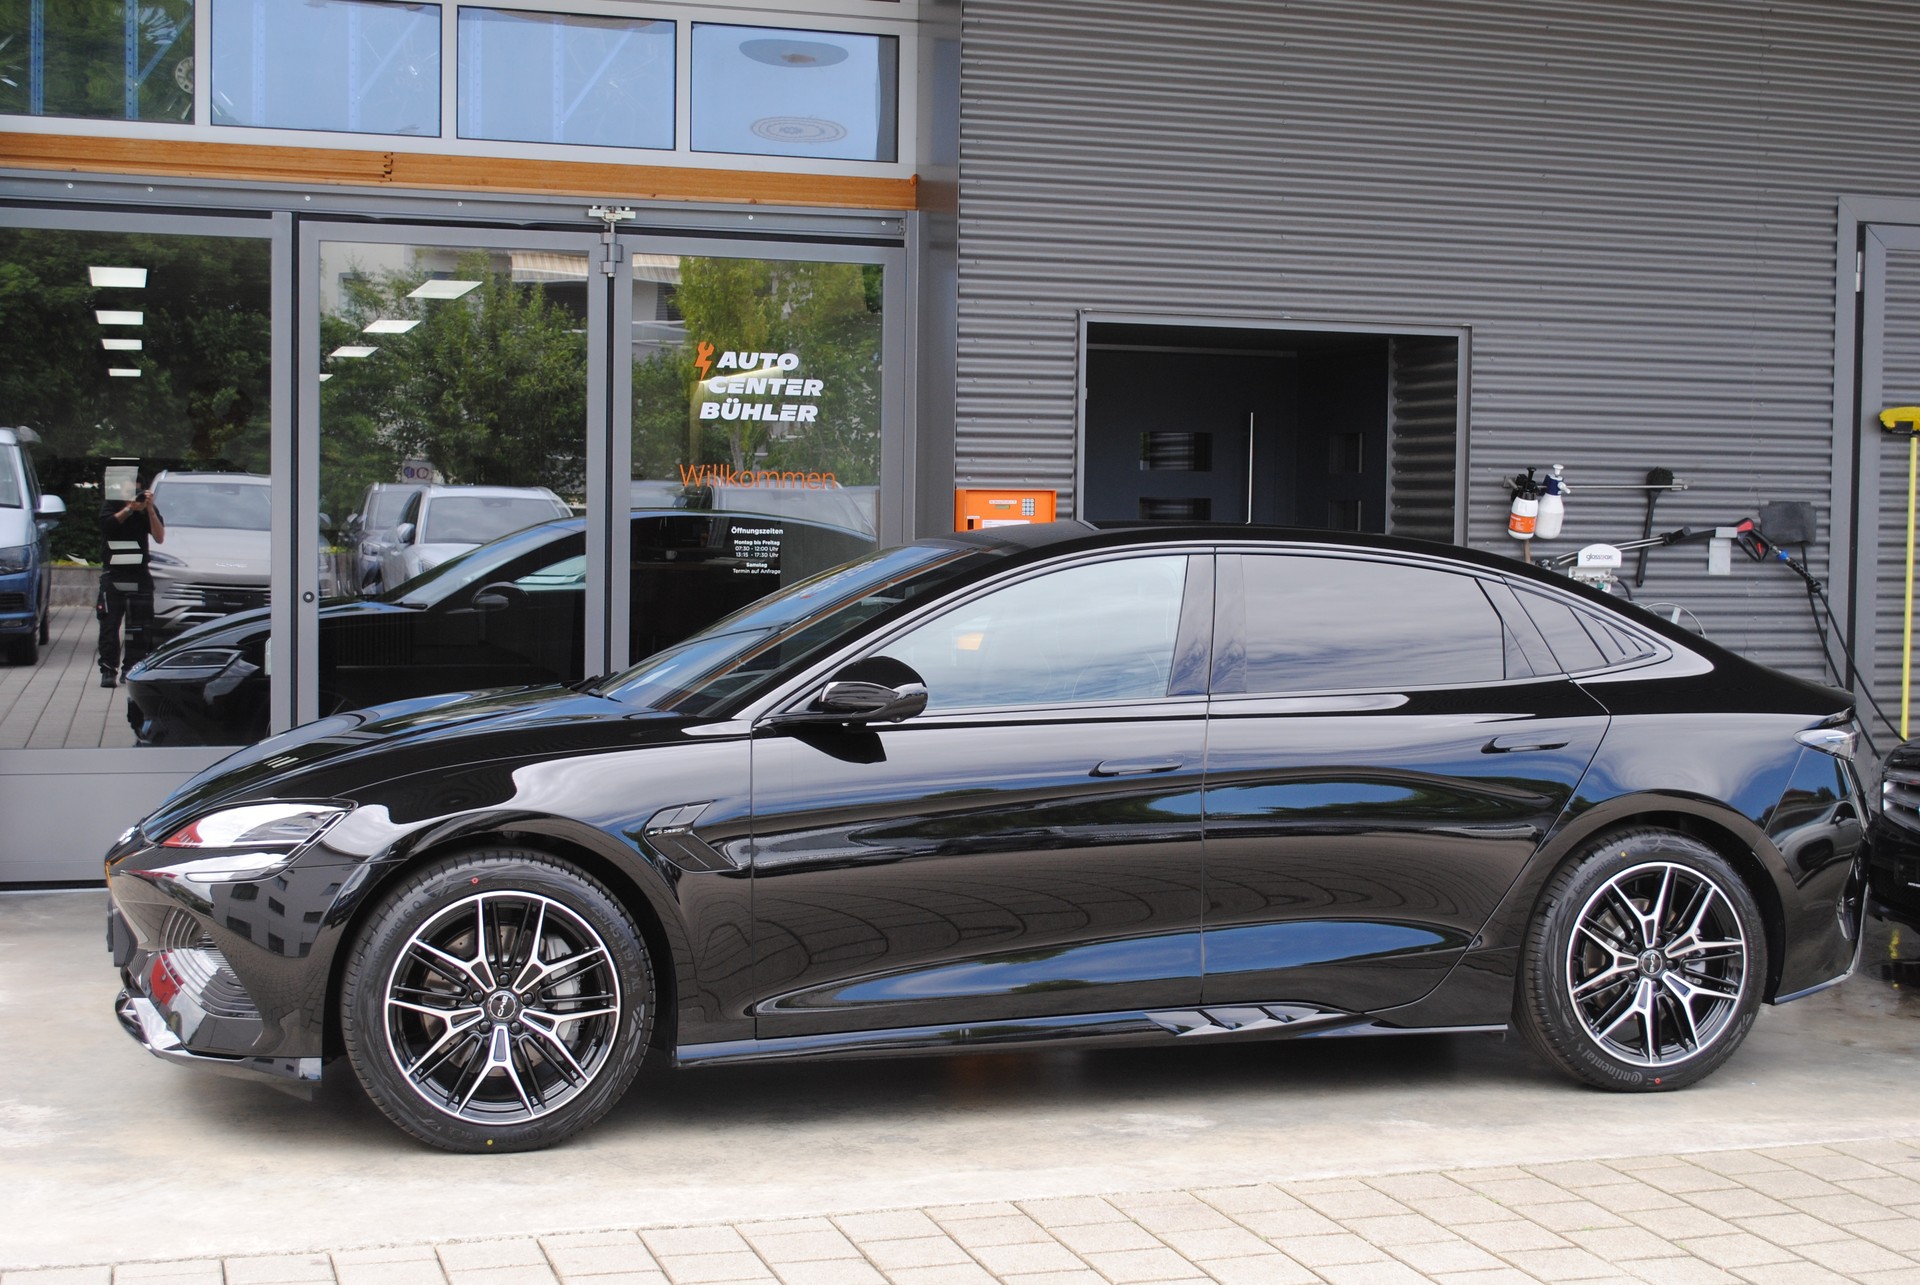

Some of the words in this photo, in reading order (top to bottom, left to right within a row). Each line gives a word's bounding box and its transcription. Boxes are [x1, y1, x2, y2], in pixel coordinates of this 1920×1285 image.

[717, 351, 799, 371] AUTO
[708, 376, 824, 396] CENTER
[699, 397, 819, 422] BÜHLER
[679, 463, 836, 489] Willkommen
[731, 526, 783, 535] Öffnungszeiten
[1580, 1048, 1643, 1085] Continental
